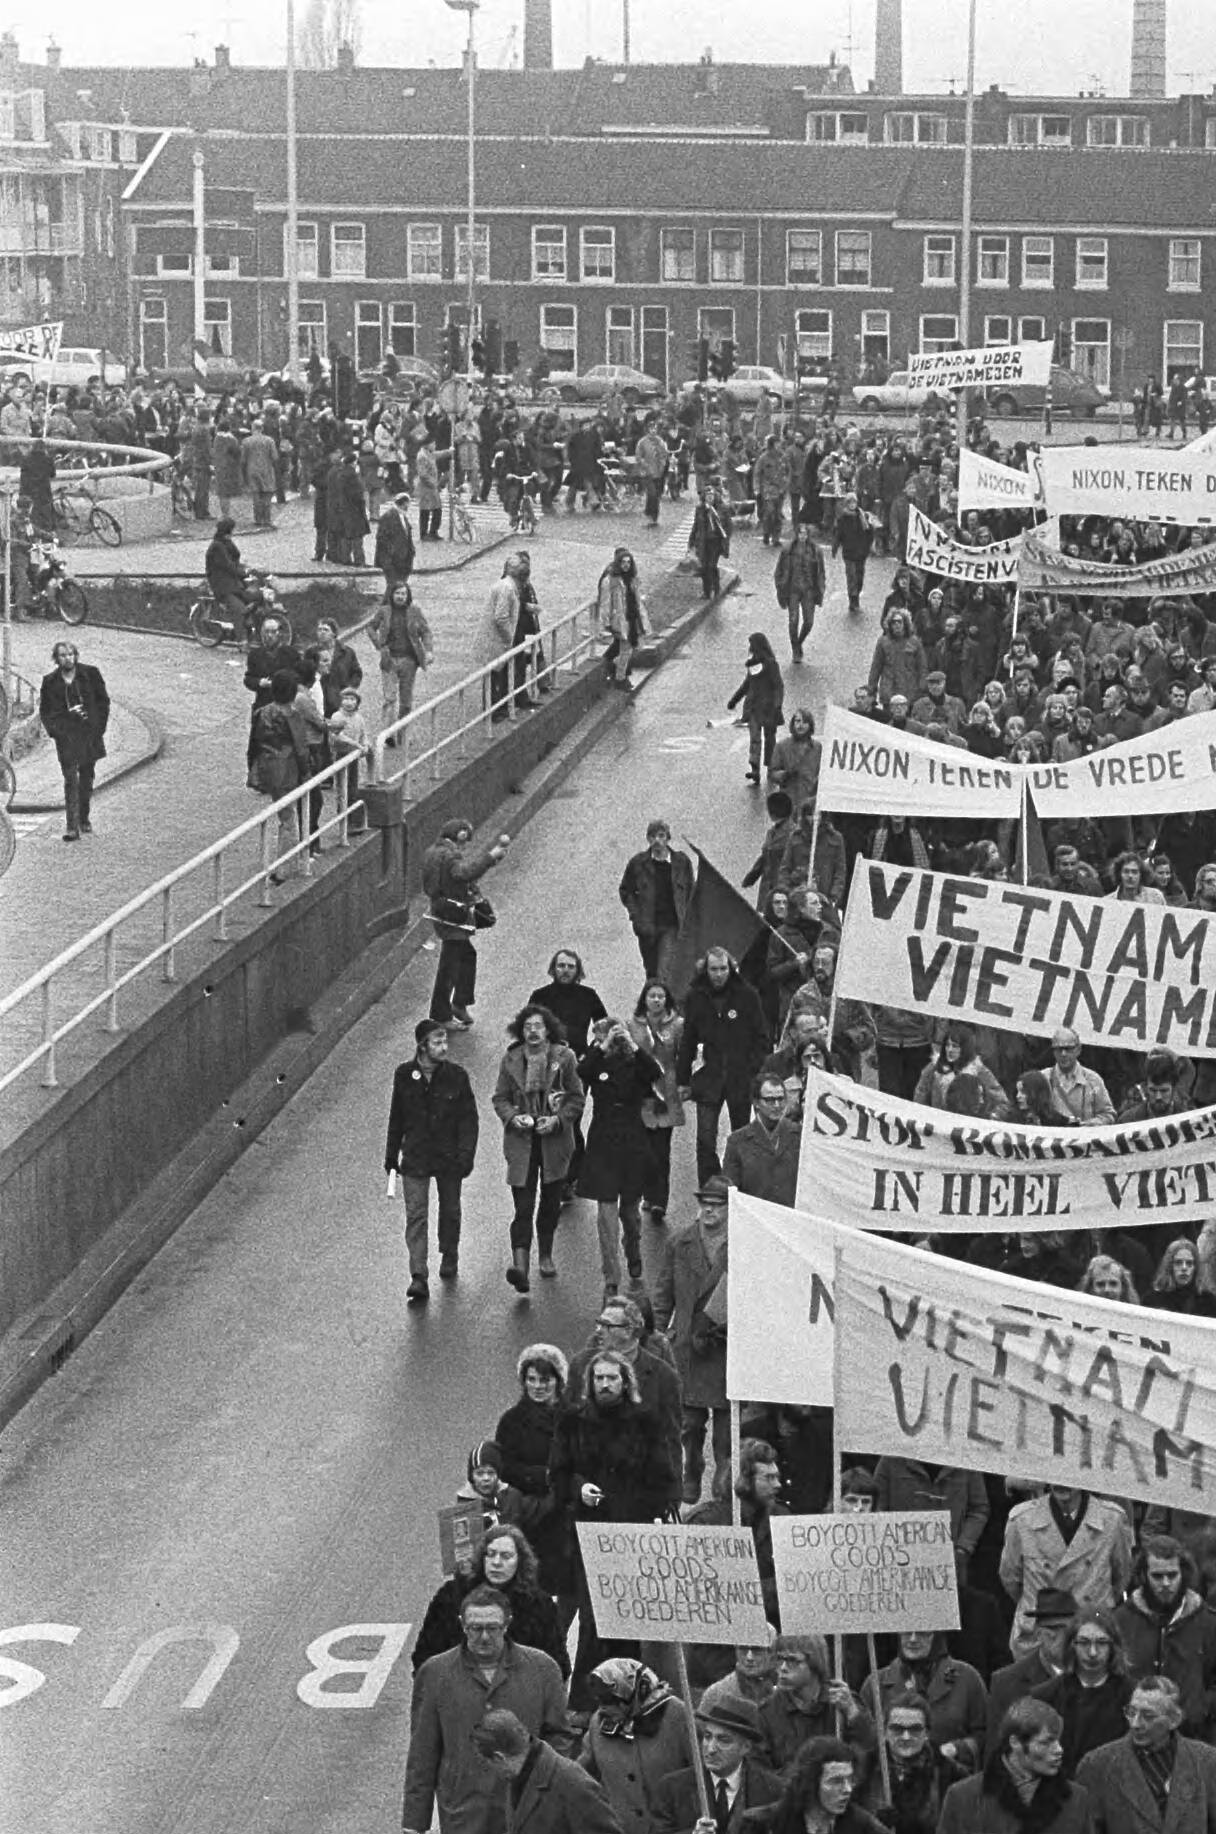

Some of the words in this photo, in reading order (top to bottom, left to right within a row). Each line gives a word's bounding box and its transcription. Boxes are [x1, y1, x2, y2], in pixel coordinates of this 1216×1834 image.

[1135, 470, 1192, 492] TEKEN
[1089, 749, 1185, 788] VREDE
[868, 865, 1210, 982] VIETNAM
[871, 1168, 922, 1214] IN
[939, 1171, 1071, 1216] HEEL
[638, 1555, 719, 1580] GOODS
[616, 1598, 732, 1625] GOEDEREN
